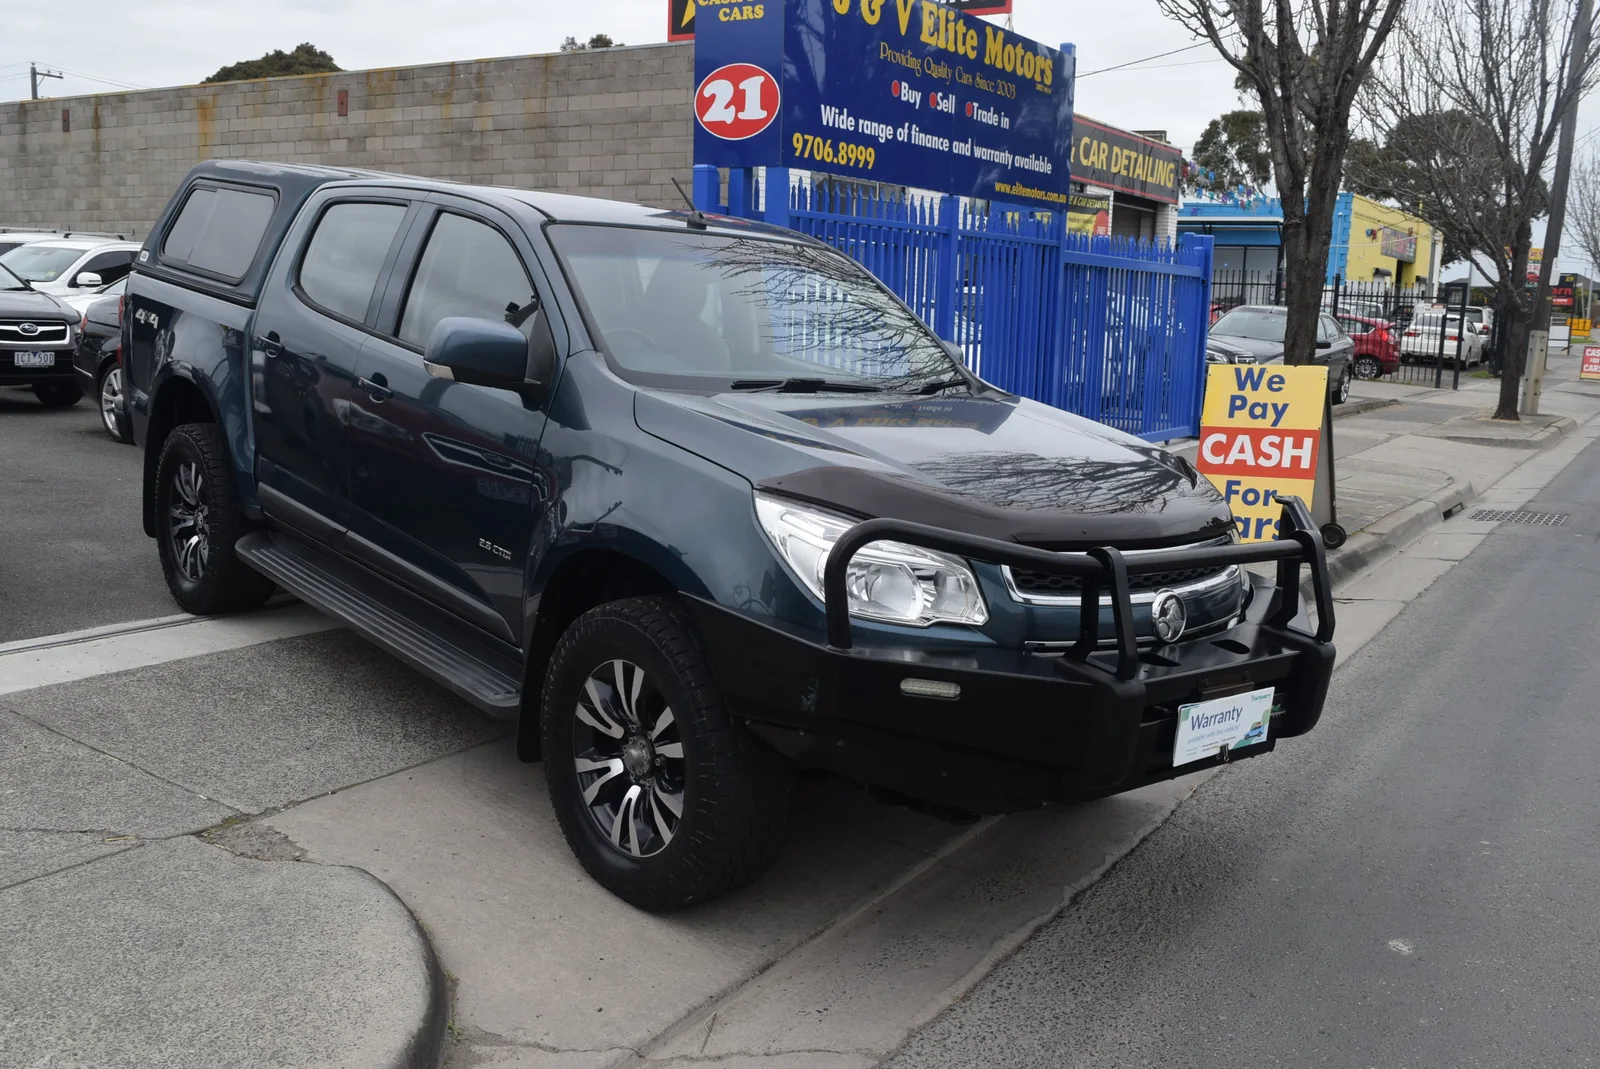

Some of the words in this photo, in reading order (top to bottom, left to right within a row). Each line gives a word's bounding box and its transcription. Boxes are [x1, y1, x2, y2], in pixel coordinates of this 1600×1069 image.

[719, 4, 765, 22] CARS
[919, 0, 978, 60] Elite
[984, 25, 1053, 86] Motors
[880, 41, 922, 77] Providing
[924, 56, 952, 85] Quality
[955, 65, 973, 86] Cars
[975, 72, 995, 93] Since
[996, 80, 1016, 100] 2003
[702, 75, 768, 125] 21
[901, 81, 922, 109] Buy
[936, 93, 955, 114] Sell
[972, 101, 999, 126] Trade
[1000, 112, 1010, 130] in
[792, 132, 876, 170] 9706.8999
[820, 104, 856, 131] Wide
[858, 118, 894, 143] range
[896, 122, 909, 142] of
[911, 124, 949, 151] finance
[952, 138, 971, 157] and
[973, 144, 1013, 170] warranty
[1014, 154, 1052, 175] available
[1079, 136, 1109, 171] CAR
[1110, 145, 1176, 188] DETAILING
[1585, 348, 1600, 357] CAS
[1234, 367, 1285, 393] We
[1227, 394, 1290, 427] Pay
[1202, 433, 1314, 469] CASH
[1224, 479, 1278, 507] For
[1191, 705, 1243, 732] Warranty
